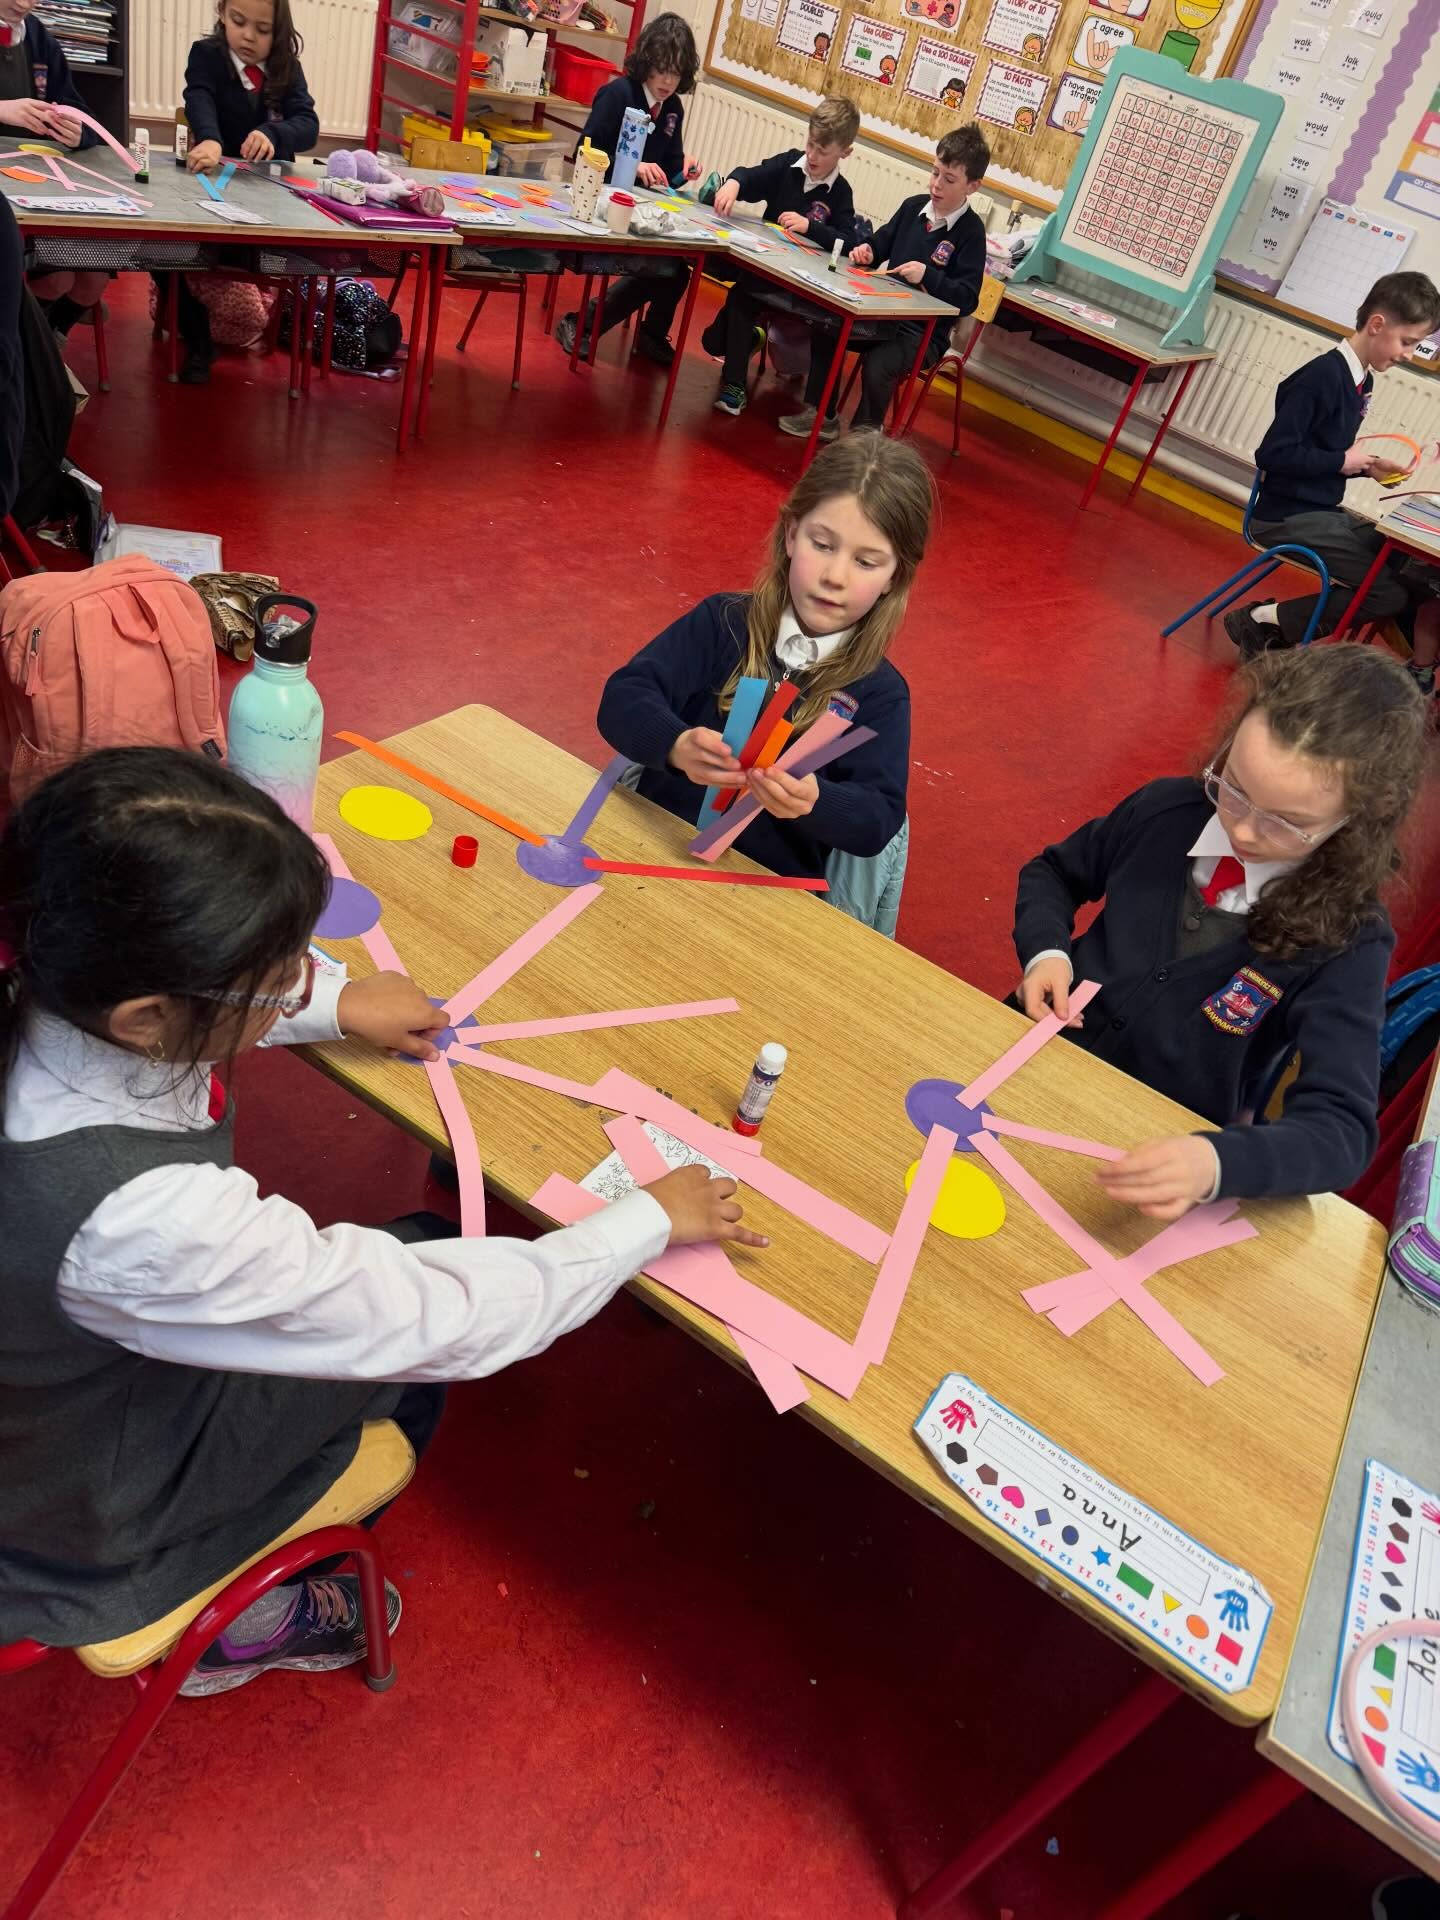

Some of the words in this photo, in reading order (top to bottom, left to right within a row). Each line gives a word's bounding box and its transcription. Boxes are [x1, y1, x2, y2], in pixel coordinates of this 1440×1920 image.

[1038, 5, 1047, 15] 10
[875, 29, 893, 41] CUBES
[1100, 24, 1124, 38] agree
[1294, 38, 1312, 46] walk
[938, 49, 948, 59] 100
[949, 53, 971, 67] SQUARE
[1344, 55, 1359, 66] talk
[1004, 71, 1012, 81] 10
[1012, 73, 1033, 88] FACTS
[1279, 69, 1301, 82] where
[1068, 80, 1085, 92] have
[1086, 86, 1101, 97] anot
[1070, 89, 1098, 105] strategy
[1320, 91, 1345, 106] should
[1305, 120, 1329, 132] would
[1120, 113, 1130, 122] 11
[1131, 117, 1141, 126] 12
[1142, 121, 1152, 130] 13
[1165, 129, 1175, 138] 15
[1188, 138, 1198, 147] 17
[1223, 150, 1233, 160] 20
[1229, 136, 1240, 145] 10
[1114, 127, 1124, 136] 21
[1136, 135, 1147, 144] 23
[1159, 144, 1169, 153] 25
[1182, 152, 1192, 161] 27
[1205, 161, 1215, 170] 29
[1217, 165, 1227, 174] 30
[1108, 141, 1119, 150] 31
[1130, 150, 1141, 159] 33
[1153, 158, 1163, 167] 35
[1176, 166, 1186, 176] 37
[1199, 175, 1209, 184] 39
[1210, 180, 1221, 189] 40
[1292, 156, 1310, 167] were
[1103, 155, 1113, 164] 41
[1125, 164, 1135, 173] 43
[1136, 168, 1146, 177] 44
[1147, 172, 1157, 181] 45
[1170, 181, 1180, 190] 47
[1181, 185, 1192, 194] 48
[1193, 189, 1203, 199] 49
[1204, 194, 1215, 203] 50
[1097, 169, 1108, 178] 51
[1108, 173, 1119, 183] 52
[1119, 178, 1130, 187] 53
[1141, 186, 1152, 195] 55
[1164, 195, 1174, 204] 57
[1175, 199, 1186, 208] 58
[1187, 204, 1197, 213] 59
[1285, 186, 1299, 195] was
[1092, 183, 1102, 192] 61
[1114, 192, 1124, 201] 63
[1125, 196, 1135, 205] 64
[1136, 200, 1146, 209] 65
[1158, 209, 1168, 218] 67
[1169, 213, 1180, 222] 68
[1181, 218, 1191, 227] 69
[1087, 197, 1097, 206] 71
[1108, 205, 1119, 214] 73
[1119, 210, 1129, 219] 74
[1130, 214, 1140, 223] 75
[1152, 223, 1163, 232] 77
[1175, 232, 1185, 241] 79
[1271, 206, 1290, 219] there
[1081, 210, 1092, 219] 81
[1103, 219, 1113, 228] 83
[1124, 228, 1135, 237] 85
[1147, 237, 1157, 246] 87
[1169, 246, 1179, 255] 89
[1076, 224, 1087, 233] 91
[1087, 228, 1097, 237] 92
[1097, 232, 1108, 242] 93
[1119, 241, 1129, 250] 95
[1141, 250, 1151, 259] 97
[1152, 255, 1162, 264] 98
[1263, 237, 1278, 247] who
[1203, 1006, 1246, 1035] BAWNMORE
[954, 1403, 973, 1418] right
[968, 1487, 981, 1498] 17
[986, 1499, 999, 1512] 16
[1004, 1512, 1017, 1525] 15
[1062, 1483, 1142, 1551] Anna
[1040, 1539, 1055, 1551] 13
[1059, 1552, 1073, 1565] 12
[1079, 1565, 1092, 1577] 11
[1096, 1579, 1111, 1592] 10
